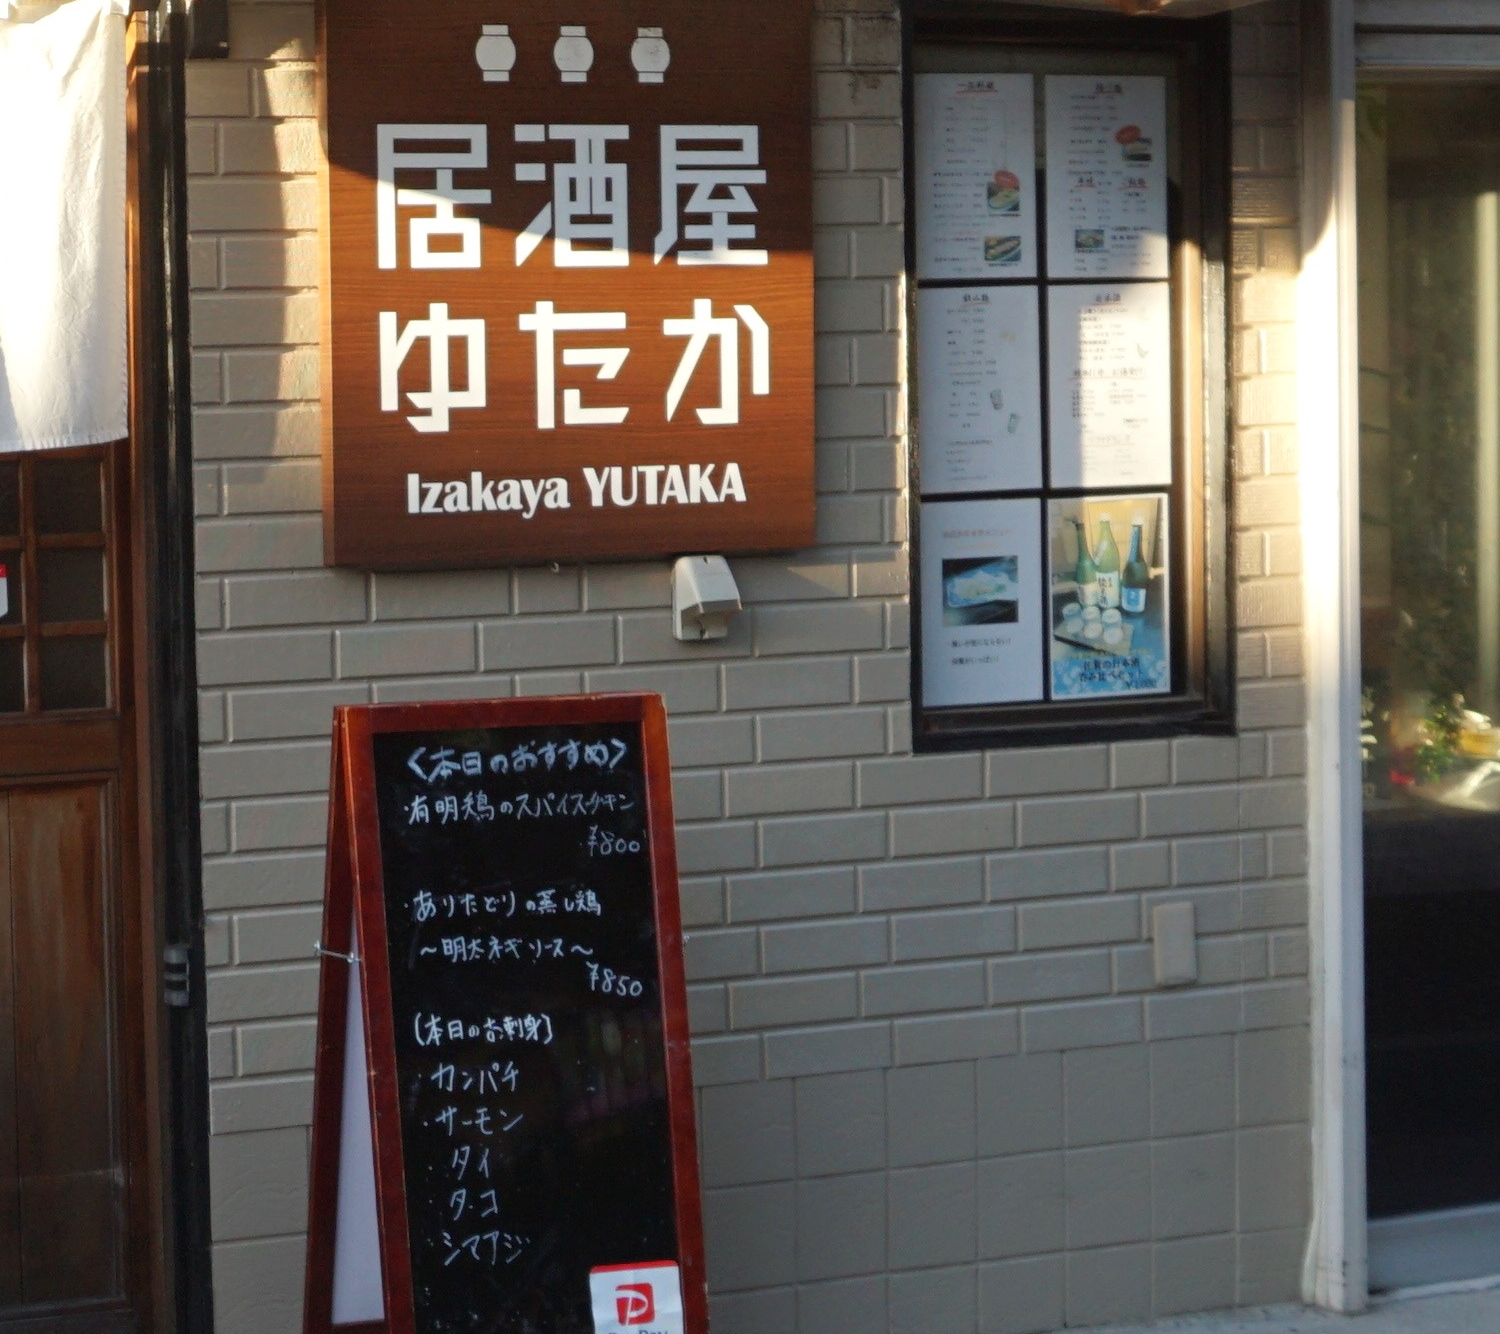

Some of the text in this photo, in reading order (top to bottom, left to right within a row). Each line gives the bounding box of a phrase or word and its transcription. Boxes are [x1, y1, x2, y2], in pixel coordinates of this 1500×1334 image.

[376, 122, 769, 269] 居酒屋
[378, 298, 770, 433] ゆたか
[407, 462, 748, 519] Izakaya YUTAKA
[587, 825, 641, 857] ¥800
[586, 960, 643, 997] ¥850
